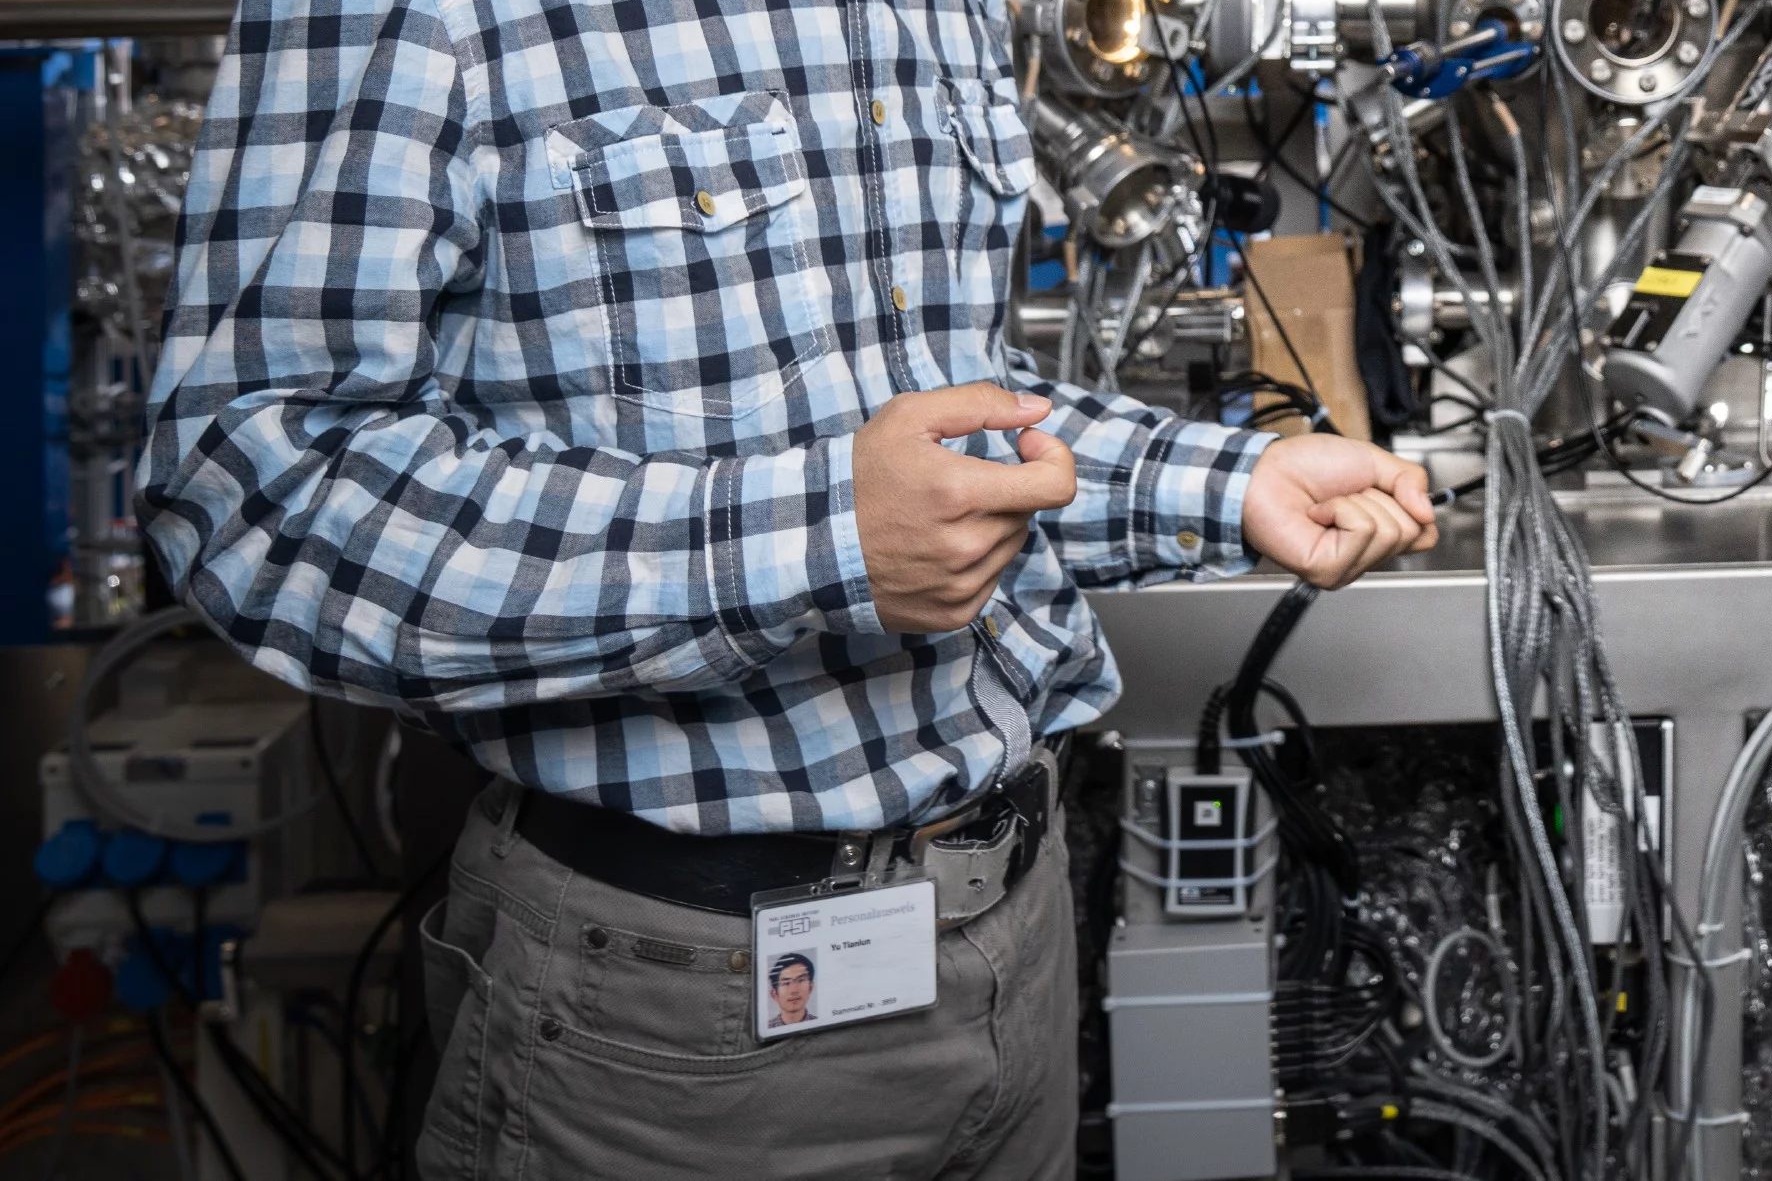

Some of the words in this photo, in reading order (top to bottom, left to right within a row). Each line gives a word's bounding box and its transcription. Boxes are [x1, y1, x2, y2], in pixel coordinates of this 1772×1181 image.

[830, 901, 915, 926] Personalausweis
[778, 916, 811, 937] PSI
[830, 943, 841, 951] Yu
[842, 937, 871, 949] Tianlun
